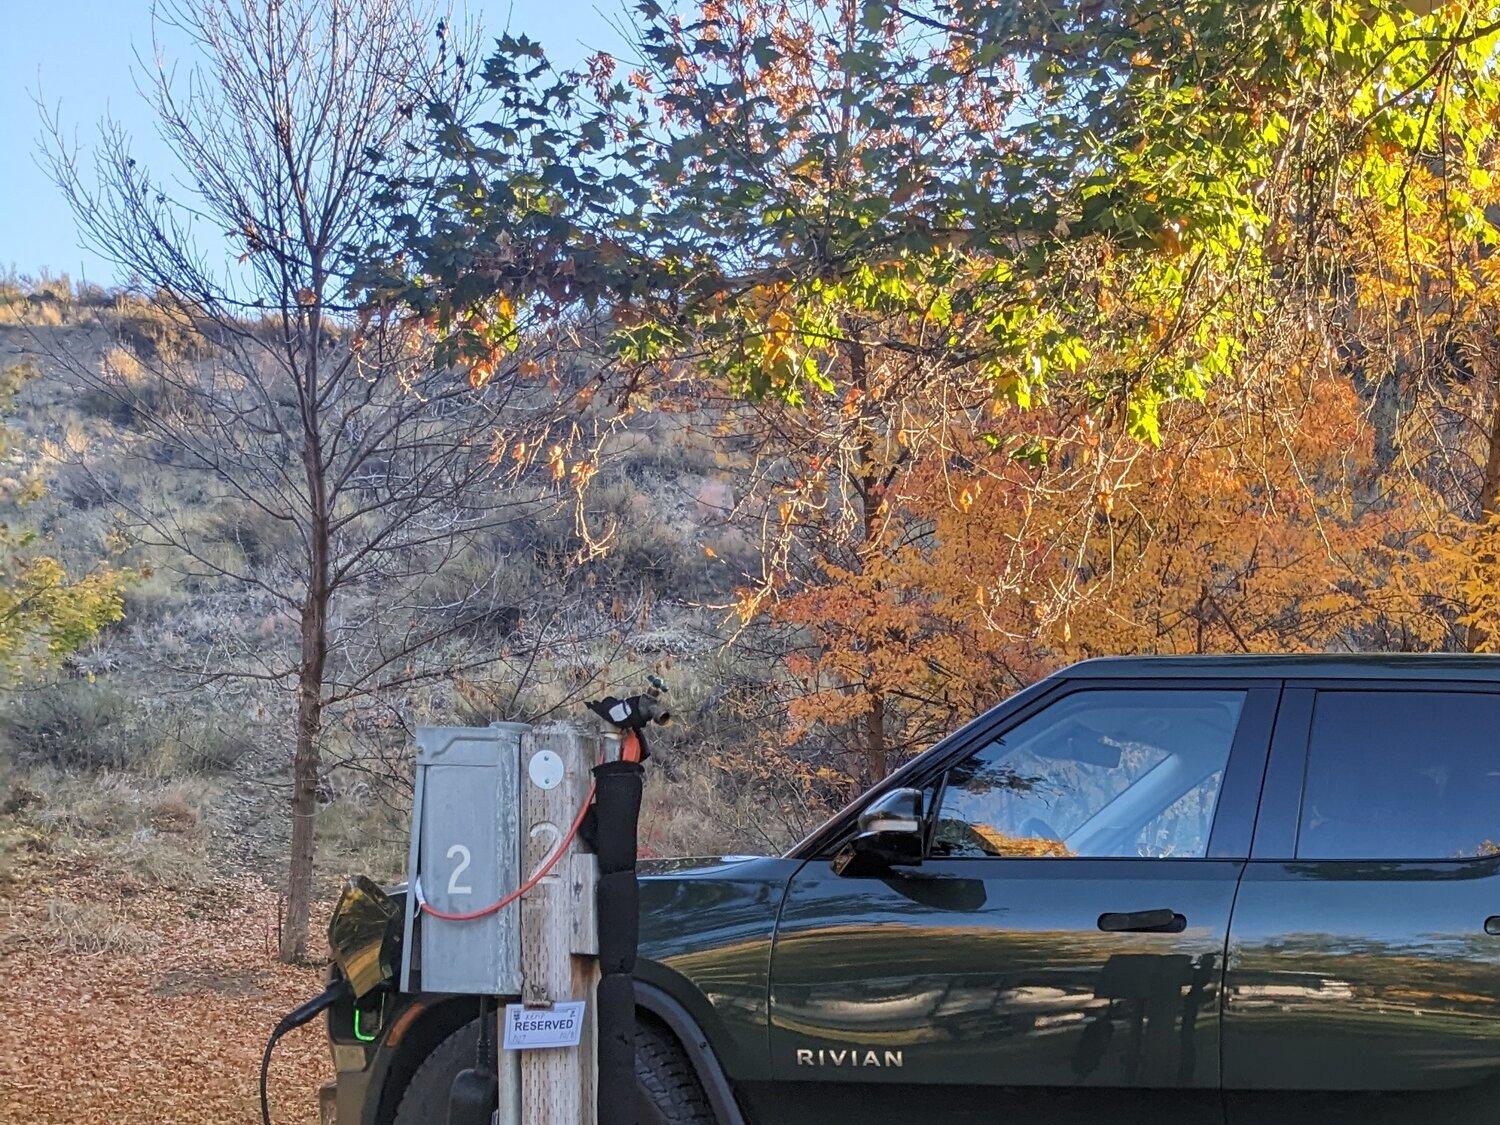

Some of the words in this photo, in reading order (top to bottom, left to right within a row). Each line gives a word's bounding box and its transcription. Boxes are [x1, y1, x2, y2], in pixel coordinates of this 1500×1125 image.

[446, 844, 472, 894] 2
[529, 821, 562, 884] 2
[514, 1018, 574, 1032] RESERVED
[796, 1048, 903, 1067] RIVIAN
